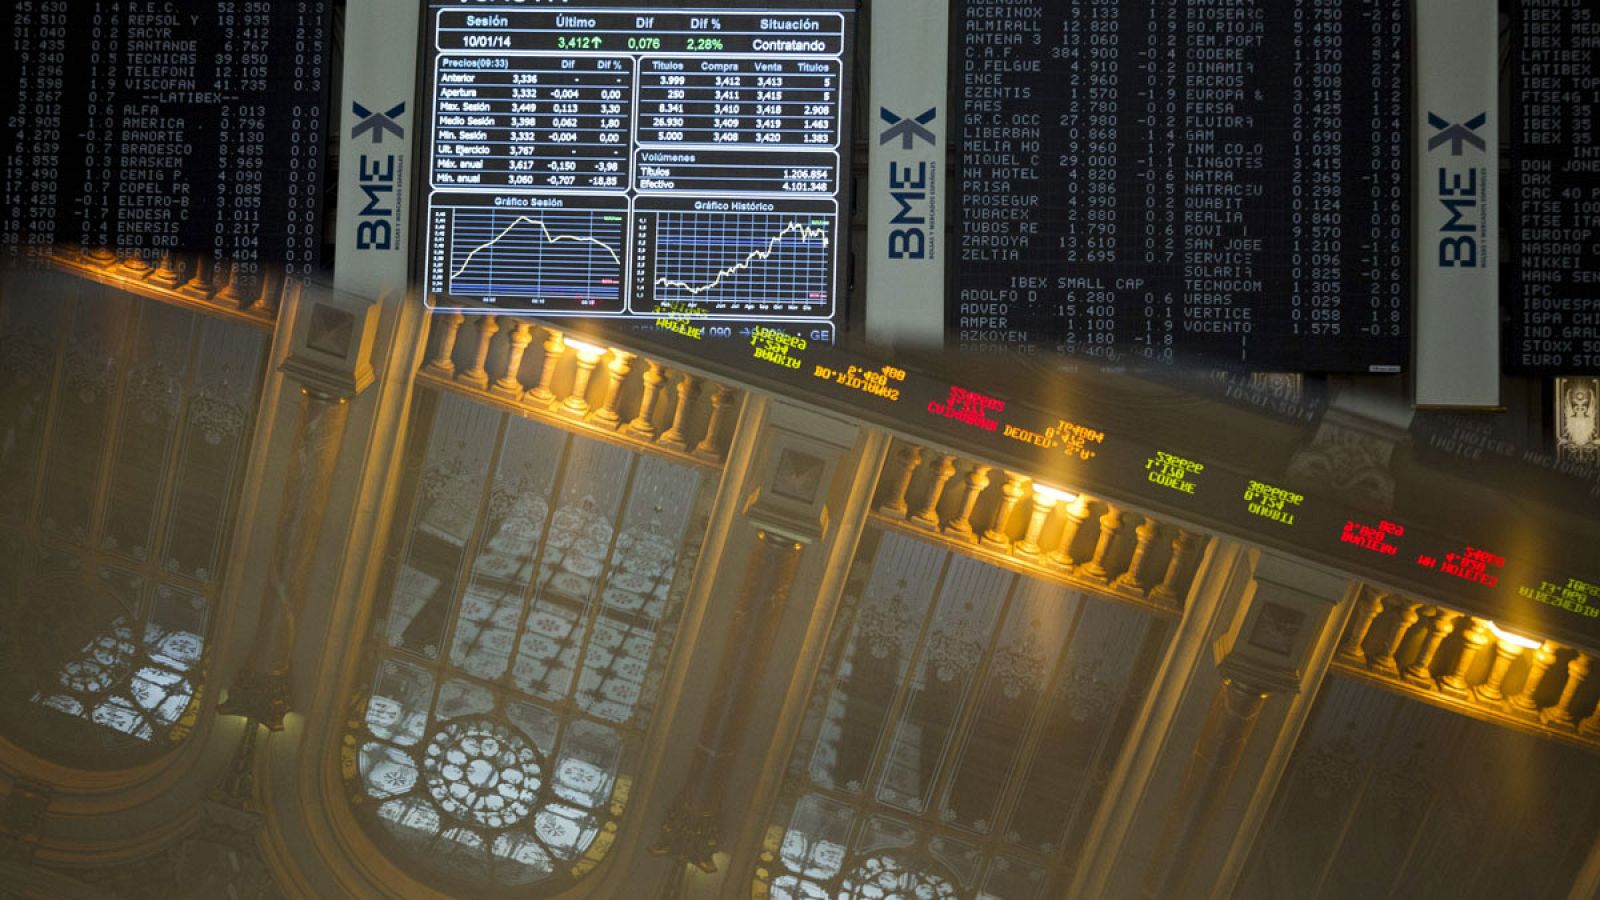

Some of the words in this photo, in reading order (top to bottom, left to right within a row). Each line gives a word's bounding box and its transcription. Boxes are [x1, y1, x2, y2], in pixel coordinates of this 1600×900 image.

[217, 2, 271, 13] 52.350
[966, 7, 1042, 18] ACERINOX
[1072, 7, 1119, 18] 9.133
[128, 14, 181, 26] REPSOL
[191, 14, 199, 26] Y
[218, 14, 271, 26] 18.935
[1523, 9, 1561, 20] IBEX
[466, 15, 508, 27] Sesión
[556, 16, 596, 28] Último
[636, 17, 655, 28] Dif
[690, 17, 708, 29] Dif
[711, 19, 721, 29] %
[760, 19, 819, 30] Situación
[966, 20, 1041, 31] ALMIRALL
[1063, 21, 1119, 32] 12.820
[128, 27, 171, 39] SACYR
[225, 27, 269, 39] 3.412
[128, 40, 197, 51] SANTANDE
[463, 35, 511, 48] 10/01/14
[558, 36, 591, 49] 3,412
[628, 37, 660, 50] 0,076
[686, 38, 723, 50] 2,28%
[752, 39, 826, 51] Contratando
[966, 35, 1022, 45] ANTENA
[1033, 35, 1042, 45] 3
[1063, 35, 1119, 46] 13.060
[127, 53, 197, 65] TECNICAS
[215, 53, 268, 65] 39.850
[1187, 49, 1244, 60] CODERE
[1295, 49, 1342, 60] 1.170
[1521, 50, 1591, 61] LATIBEX
[562, 60, 575, 68] Dif
[597, 61, 611, 69] Dif
[613, 61, 622, 69] %
[701, 63, 738, 72] Compra
[755, 63, 782, 71] Venta
[1071, 61, 1118, 73] 4.910
[127, 66, 195, 77] TELEFONI
[125, 79, 196, 90] VISCOFAN
[441, 74, 475, 82] Anterior
[513, 75, 538, 84] 3,336
[716, 78, 740, 87] 3,412
[757, 78, 782, 87] 3,413
[965, 74, 1002, 85] ENCE
[1186, 76, 1244, 87] ERCROS
[440, 89, 477, 97] Apertura
[512, 89, 537, 99] 3,332
[550, 90, 579, 99] -0,004
[601, 90, 621, 99] 0,00
[715, 91, 740, 101] 3,411
[965, 87, 1031, 98] EZENTIS
[124, 105, 159, 116] ALFA
[462, 102, 491, 112] Sesión
[553, 105, 578, 114] 0,113
[601, 105, 620, 114] 3,30
[965, 101, 1002, 111] FAES
[1186, 103, 1234, 114] FERSA
[123, 118, 185, 129] AMERICA
[439, 117, 465, 125] Medio
[467, 116, 495, 126] Sesión
[122, 131, 183, 142] BANORTE
[459, 130, 487, 140] Sesión
[510, 132, 535, 141] 3,332
[548, 133, 577, 142] -0,004
[600, 133, 619, 143] 0,00
[756, 134, 780, 143] 3,420
[964, 128, 1040, 139] LIBERBAN
[1185, 130, 1215, 141] GAM
[122, 144, 192, 155] BRADESCO
[964, 142, 1011, 152] MELIA
[1022, 142, 1039, 152] HO
[121, 157, 183, 168] BRASKEM
[460, 160, 484, 169] anual
[509, 161, 534, 170] 3,617
[547, 162, 576, 171] -0,150
[1521, 160, 1551, 172] DOW
[120, 170, 164, 181] CEMIG
[964, 168, 982, 179] NH
[992, 168, 1039, 179] HOTEL
[1185, 171, 1233, 181] NATRA
[457, 174, 480, 183] anual
[508, 175, 533, 184] 3,060
[546, 176, 575, 185] -0,707
[640, 181, 674, 189] Efectivo
[1521, 174, 1551, 185] DAX
[120, 183, 161, 194] COPEL
[173, 183, 190, 194] PR
[964, 182, 1010, 193] PRISA
[357, 155, 394, 250] BME
[530, 197, 563, 207] Sesión
[732, 202, 774, 211] Histórico
[963, 195, 1039, 206] PROSEGUR
[1069, 196, 1116, 207] 4.990
[888, 161, 926, 259] BME
[1522, 201, 1561, 213] FTSE
[118, 209, 172, 220] ENDESA
[180, 209, 190, 220] C
[963, 209, 1029, 219] TUBACEX
[1438, 167, 1477, 268] BME
[118, 221, 180, 233] ENERSIS
[216, 222, 260, 234] 0.217
[1522, 229, 1592, 240] EUROTOP
[1522, 257, 1580, 269] NIKKEI
[1522, 270, 1561, 282] HANG
[1010, 277, 1048, 289] IBEX
[1059, 277, 1104, 289] SMALL
[1116, 278, 1144, 290] CAP
[1185, 280, 1263, 292] TECNOCOM
[961, 290, 1018, 301] ADOLFO
[960, 317, 1008, 329] AMPER
[1184, 322, 1251, 333] VOCENTO
